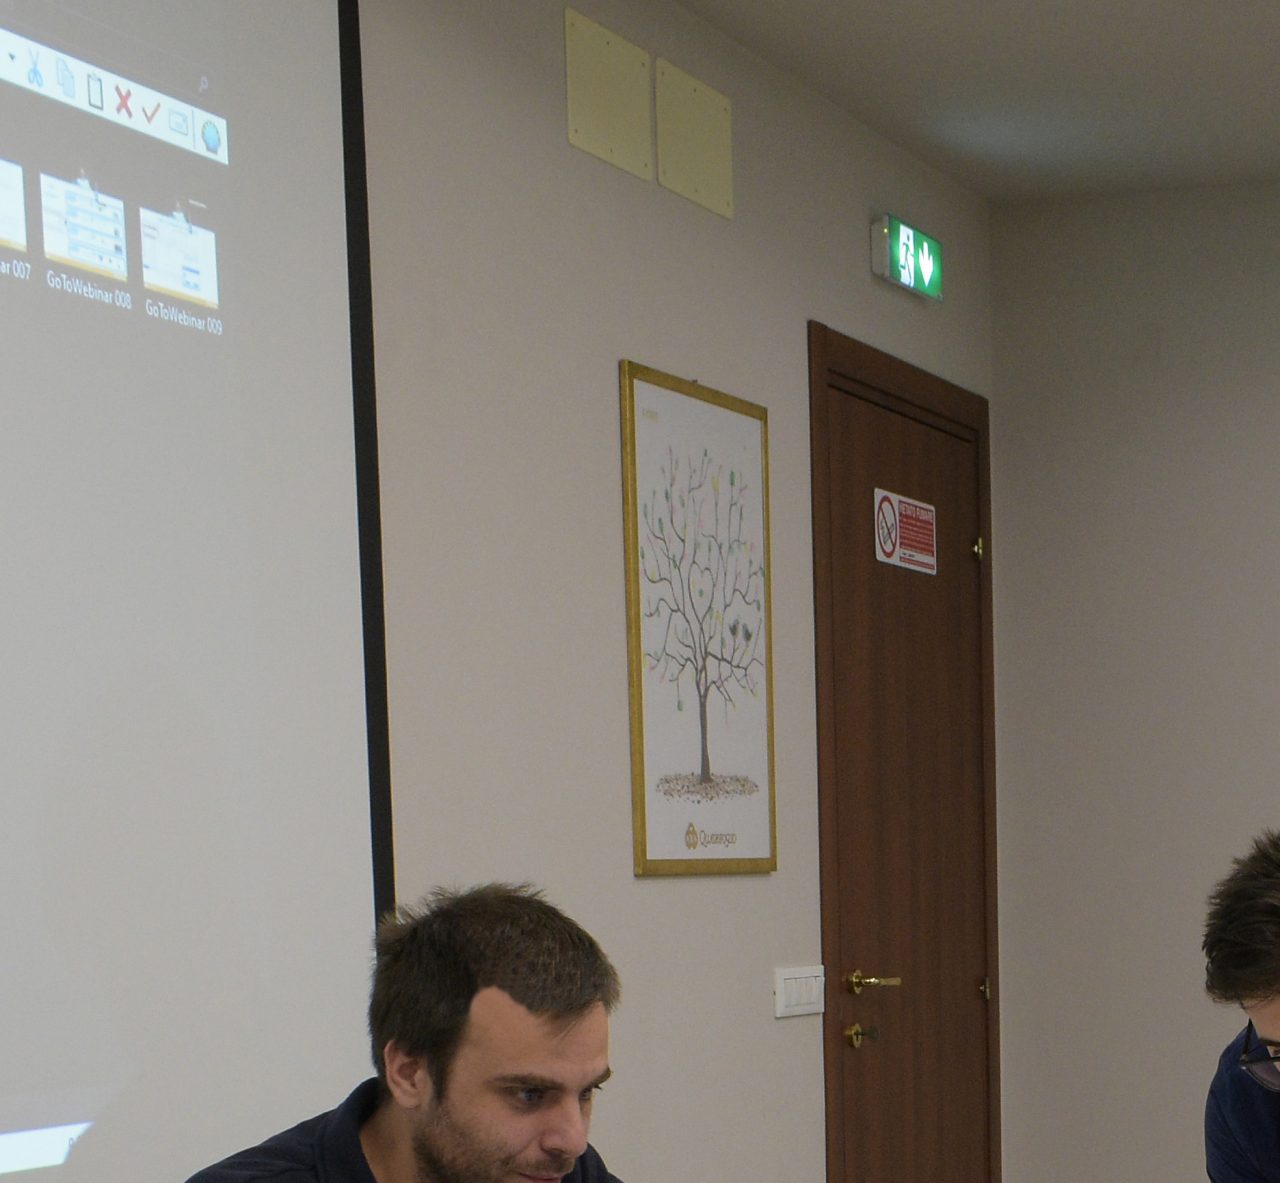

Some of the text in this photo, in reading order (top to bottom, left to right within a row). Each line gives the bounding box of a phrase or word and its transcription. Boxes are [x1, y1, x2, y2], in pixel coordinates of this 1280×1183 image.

[12, 259, 31, 279] 007
[47, 269, 132, 309] GoToWebinar 008
[145, 299, 223, 336] GoToWebinar 009
